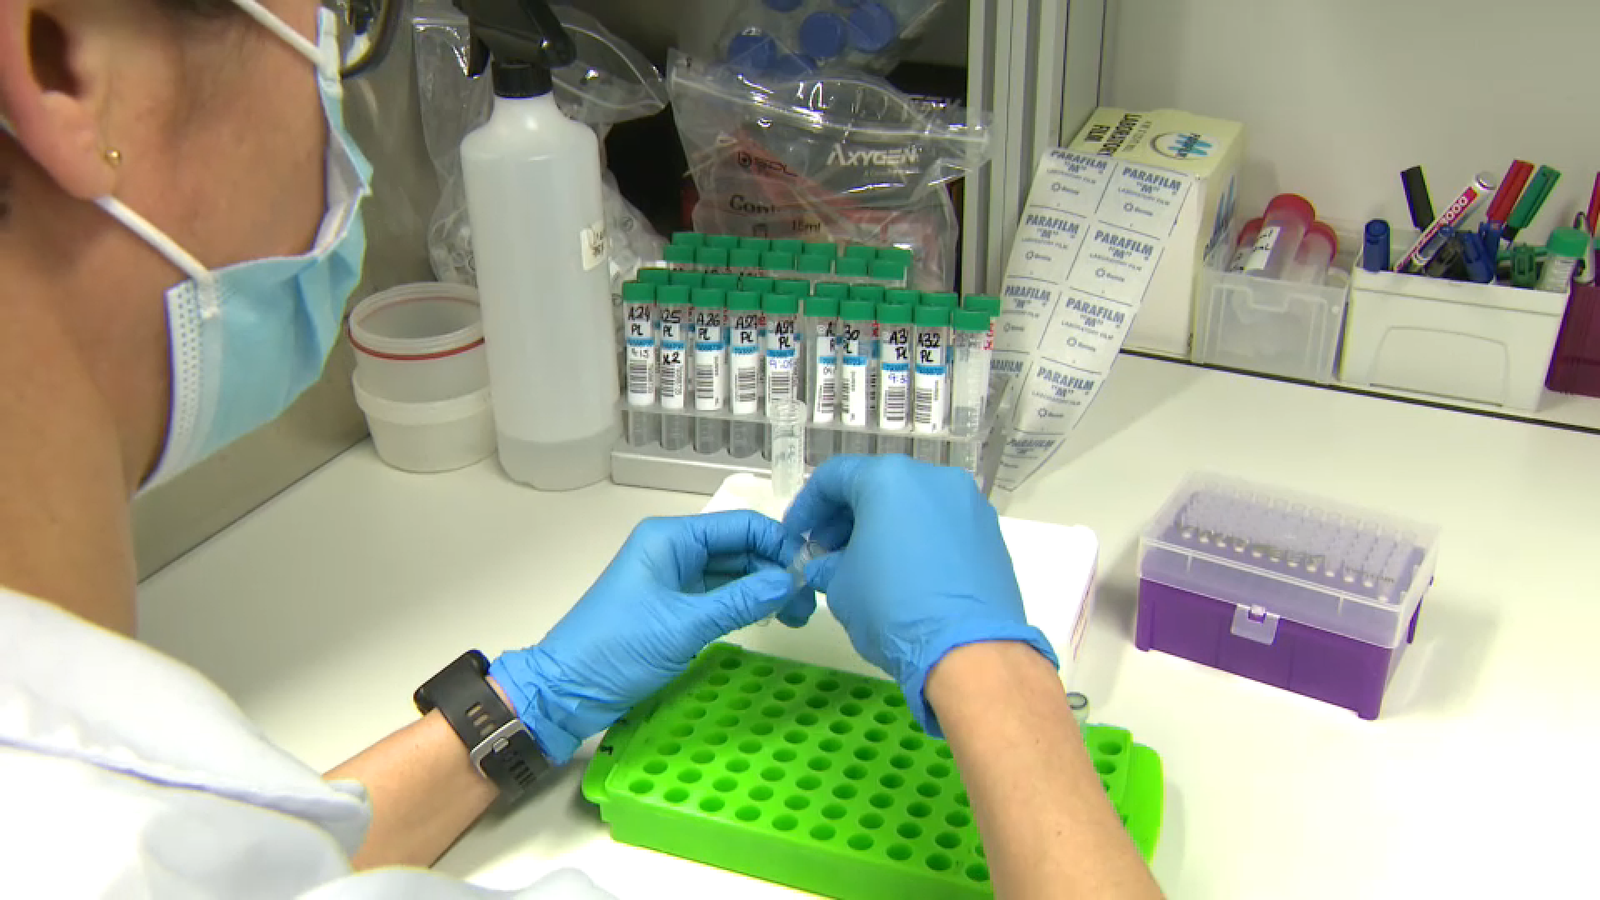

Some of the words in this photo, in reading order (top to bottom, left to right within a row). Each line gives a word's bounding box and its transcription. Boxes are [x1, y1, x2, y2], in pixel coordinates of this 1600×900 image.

[1051, 150, 1108, 170] PARAFILM
[1122, 167, 1182, 191] PARAFILM
[1026, 214, 1080, 234] PARAFILM
[1094, 229, 1154, 257] PARAFILM
[1005, 285, 1051, 301] PARAFILM
[628, 306, 650, 322] A24
[1066, 297, 1126, 324] PARAFILM
[697, 312, 721, 327] A26
[631, 323, 644, 336] PL
[663, 324, 674, 337] PL
[698, 328, 711, 341] PL
[740, 331, 754, 344] PL
[778, 336, 791, 348] PL
[917, 333, 941, 348] A32
[920, 350, 934, 363] PL
[1036, 366, 1096, 391] PARAFILM
